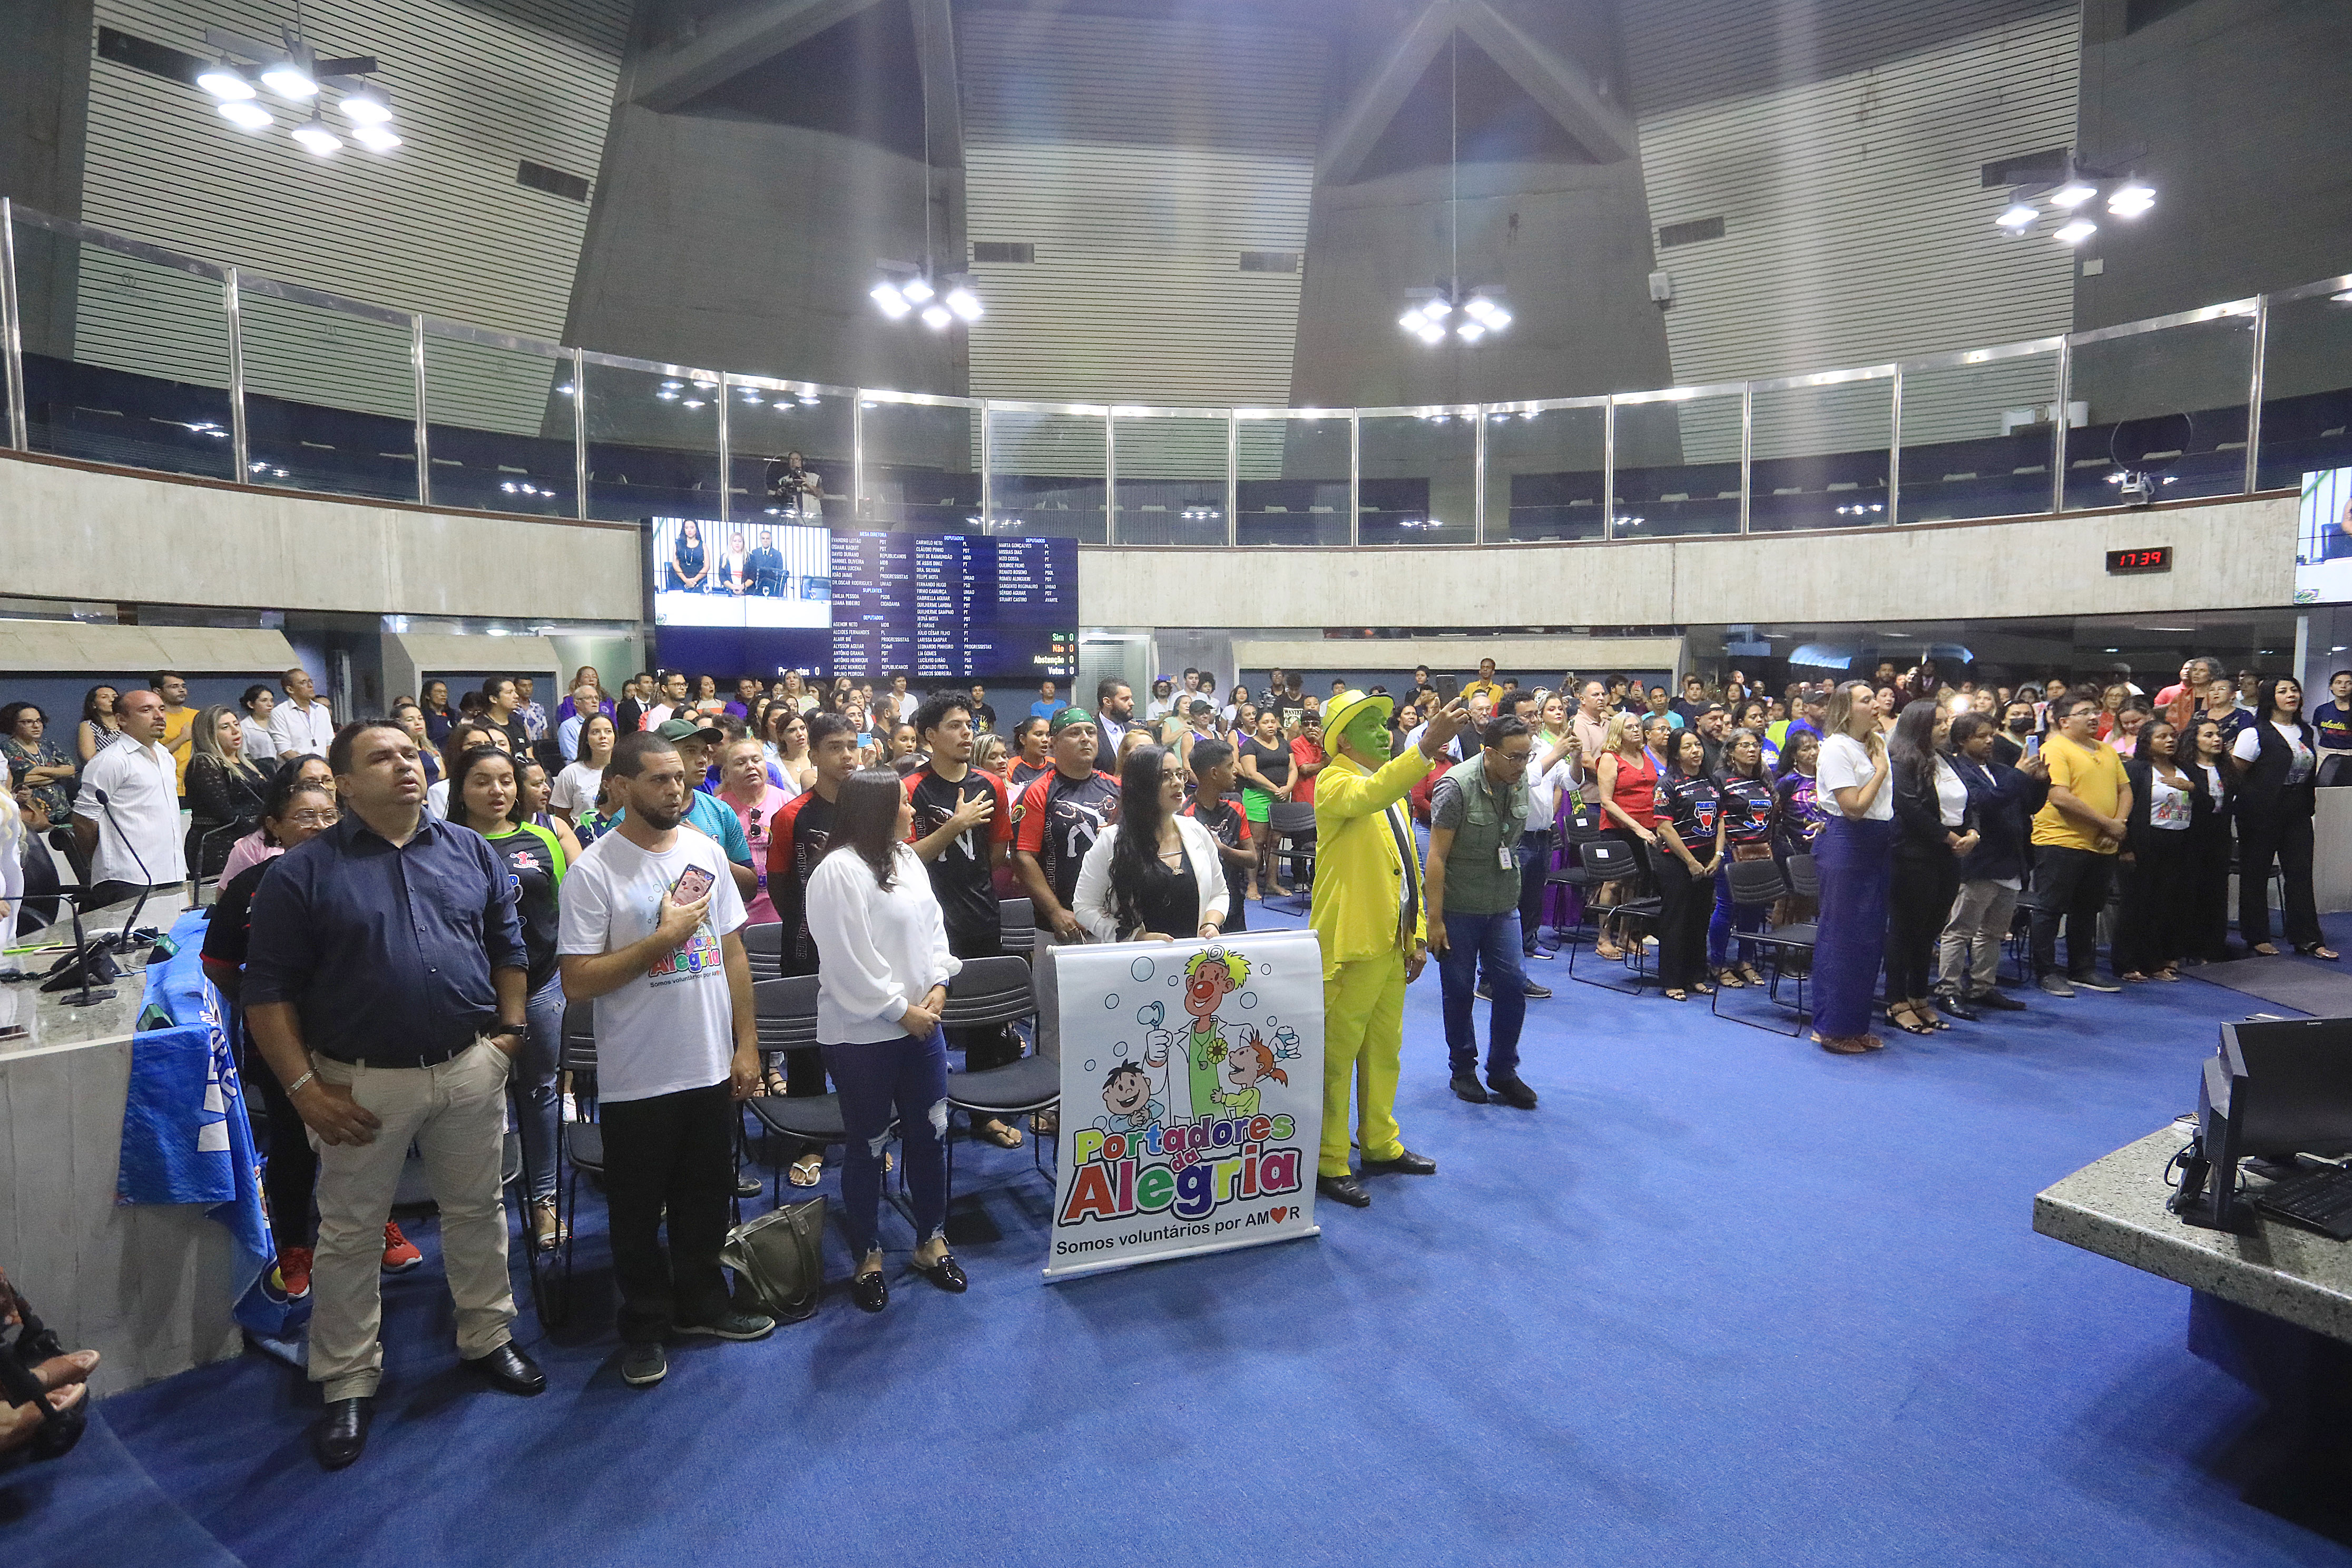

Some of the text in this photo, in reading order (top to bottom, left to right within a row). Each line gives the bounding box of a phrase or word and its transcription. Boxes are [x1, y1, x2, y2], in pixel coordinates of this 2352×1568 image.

[1034, 655, 1064, 665] Abstenção
[1074, 1113, 1296, 1166] Portadores
[1170, 1147, 1201, 1173] da
[1058, 1142, 1302, 1228] Alegria
[1056, 1237, 1114, 1255] Somos
[1119, 1223, 1210, 1246] voluntários
[1215, 1218, 1241, 1235] por
